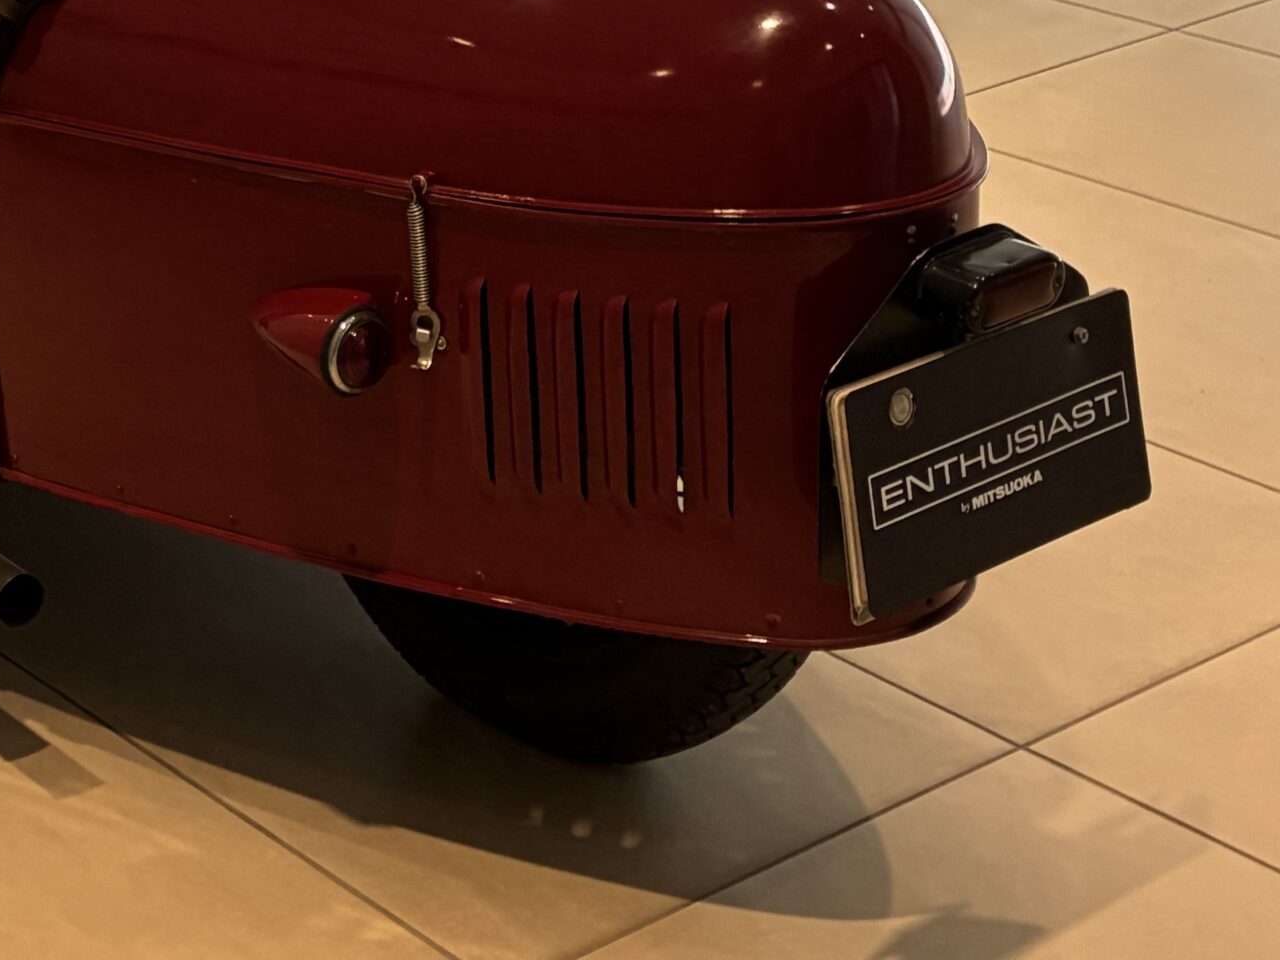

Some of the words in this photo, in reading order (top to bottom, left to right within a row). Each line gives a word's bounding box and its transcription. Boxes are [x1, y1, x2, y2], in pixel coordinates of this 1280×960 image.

[880, 389, 1117, 511] ENTHUSIAST
[960, 502, 971, 514] by
[971, 469, 1043, 510] MITSUOKA
